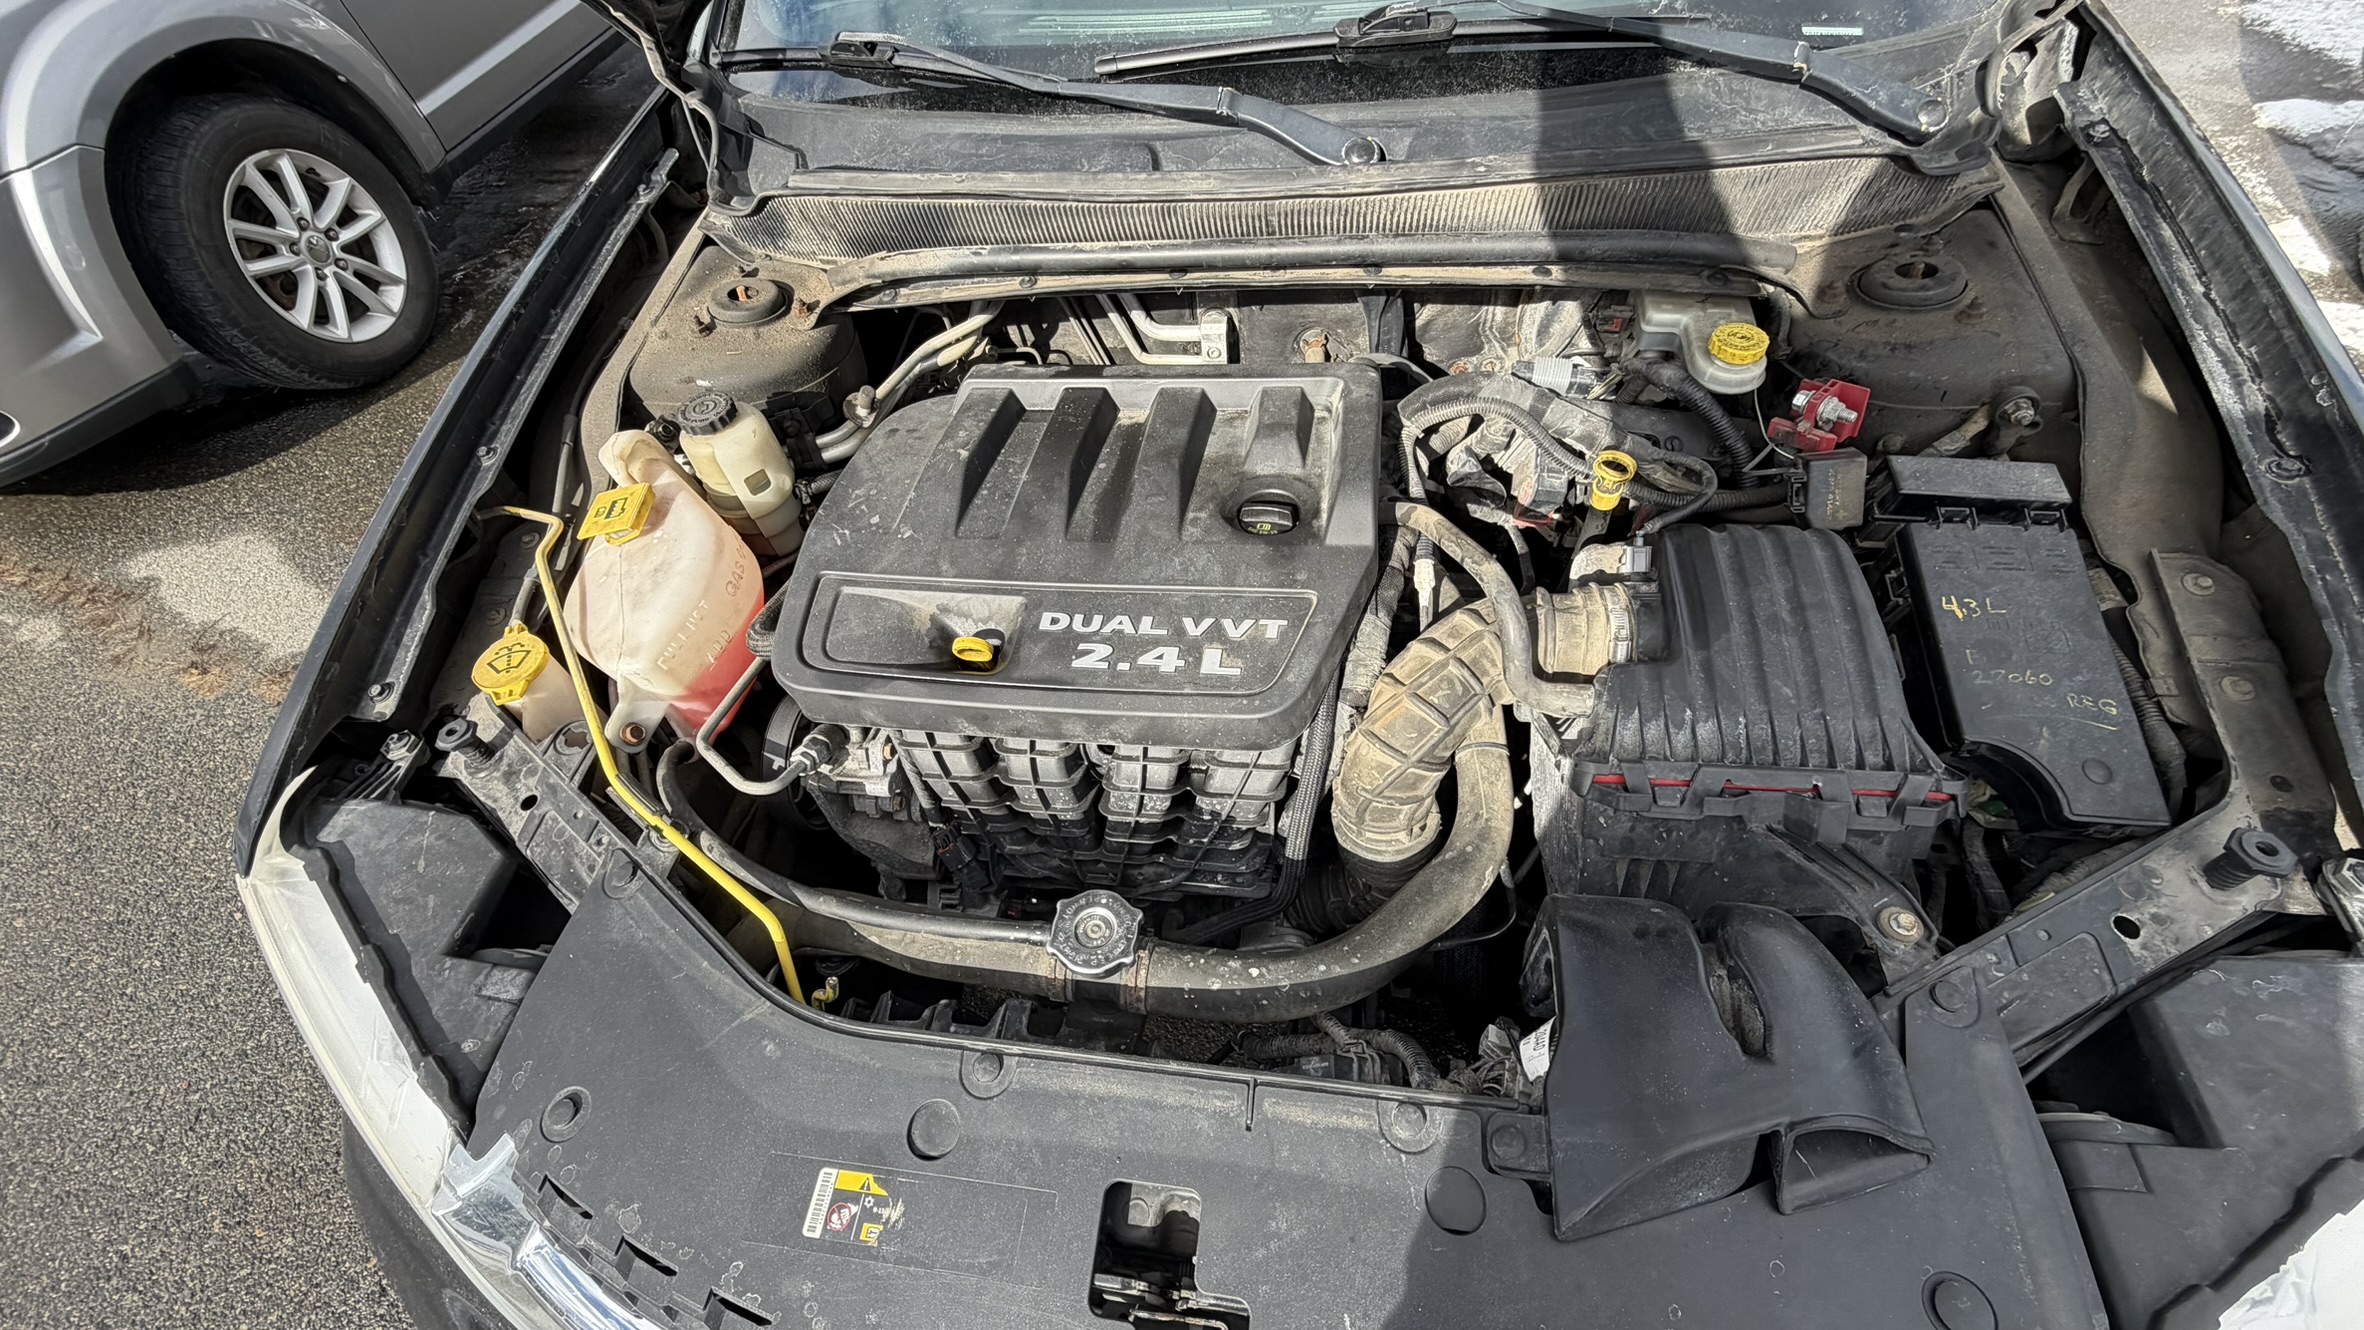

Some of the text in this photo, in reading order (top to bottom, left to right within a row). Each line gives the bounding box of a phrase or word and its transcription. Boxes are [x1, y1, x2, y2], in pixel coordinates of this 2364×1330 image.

[1986, 597, 2007, 614] L
[1038, 611, 1290, 640] DUAL VVT
[657, 632, 687, 671] FULL
[1071, 642, 1243, 676] 2.4 L
[1971, 668, 2054, 686] 27060
[2066, 692, 2119, 715] REG
